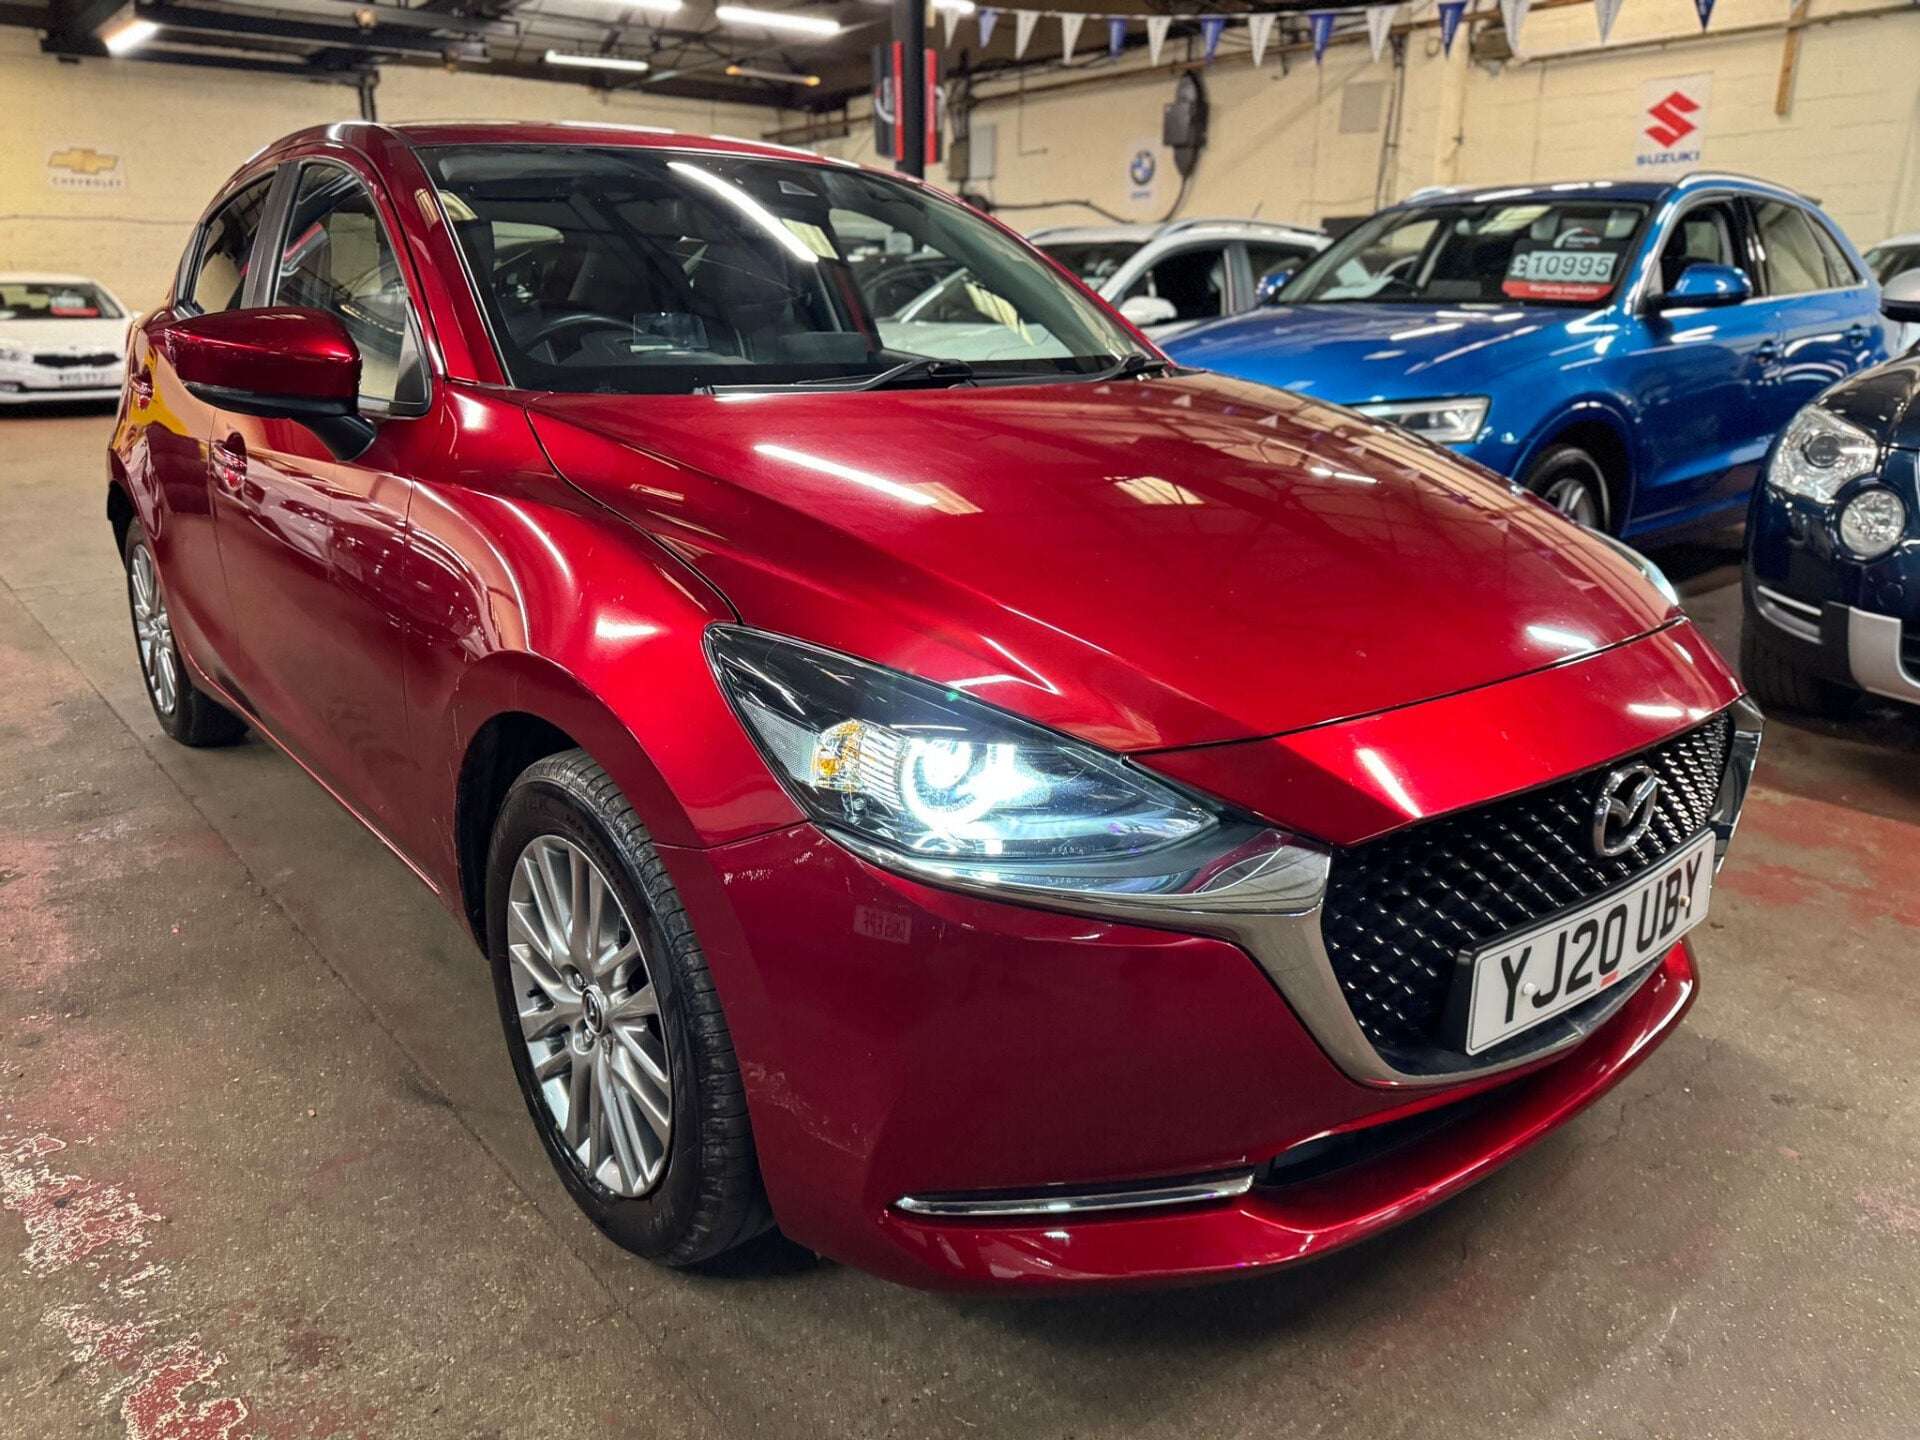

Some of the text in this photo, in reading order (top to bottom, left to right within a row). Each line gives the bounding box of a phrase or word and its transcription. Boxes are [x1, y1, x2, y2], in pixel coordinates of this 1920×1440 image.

[1636, 151, 1700, 166] SUZUKI
[1510, 254, 1613, 277] £10995
[1501, 851, 1703, 1025] YJ20 UBY
